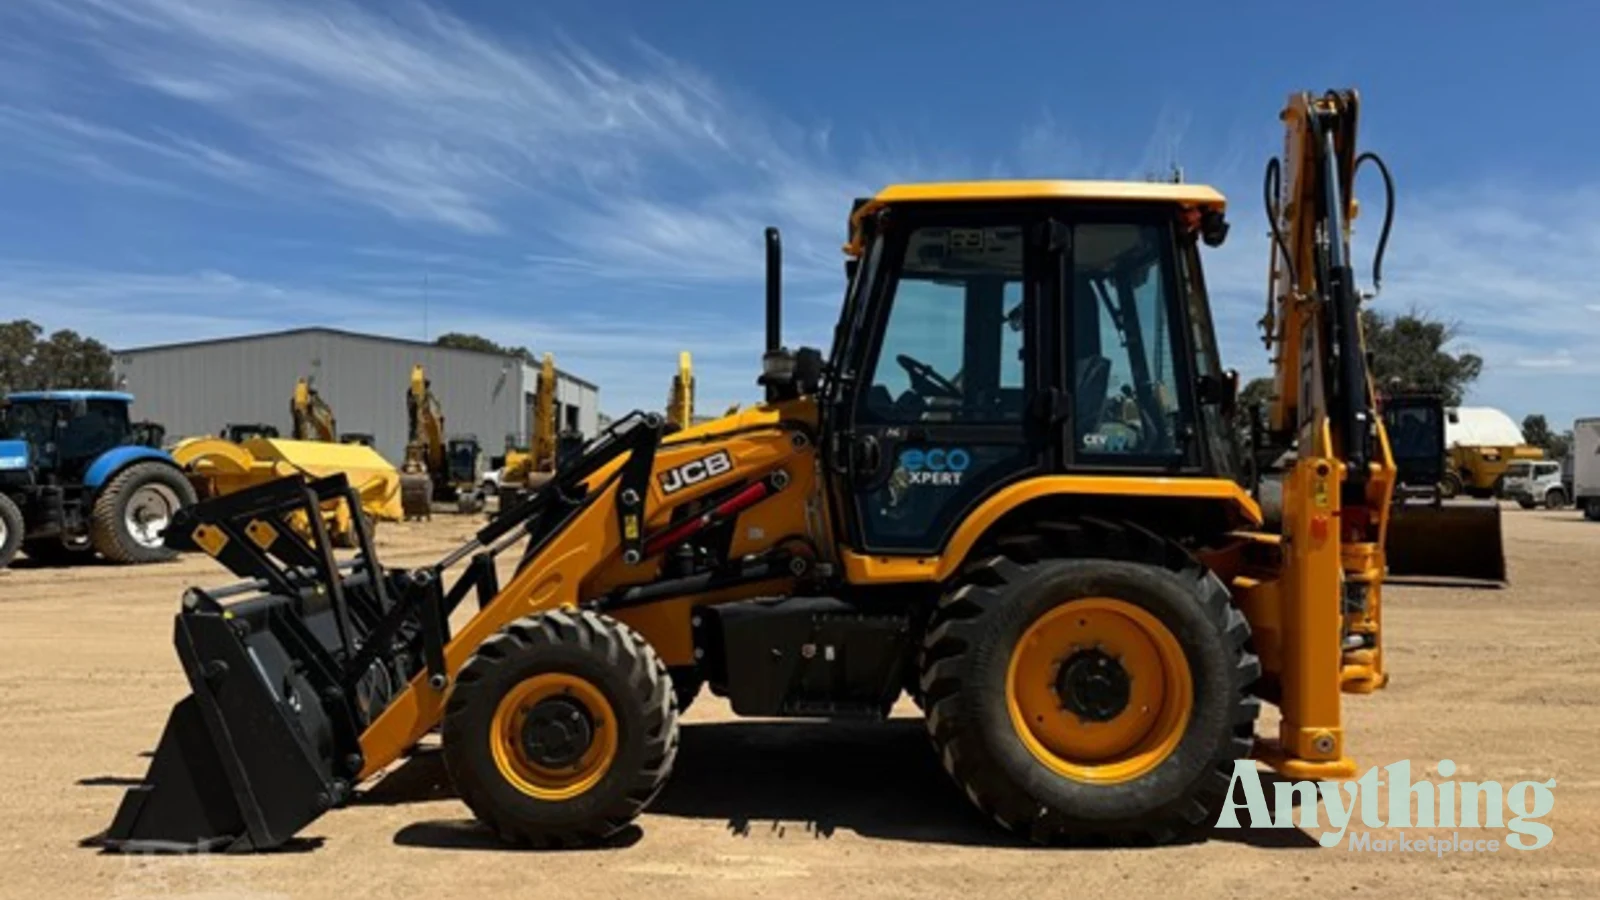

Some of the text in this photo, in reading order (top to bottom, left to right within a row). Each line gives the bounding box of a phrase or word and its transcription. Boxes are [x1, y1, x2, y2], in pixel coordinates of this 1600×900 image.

[899, 448, 970, 471] eco
[663, 452, 731, 492] JCB
[908, 472, 963, 485] XPERT
